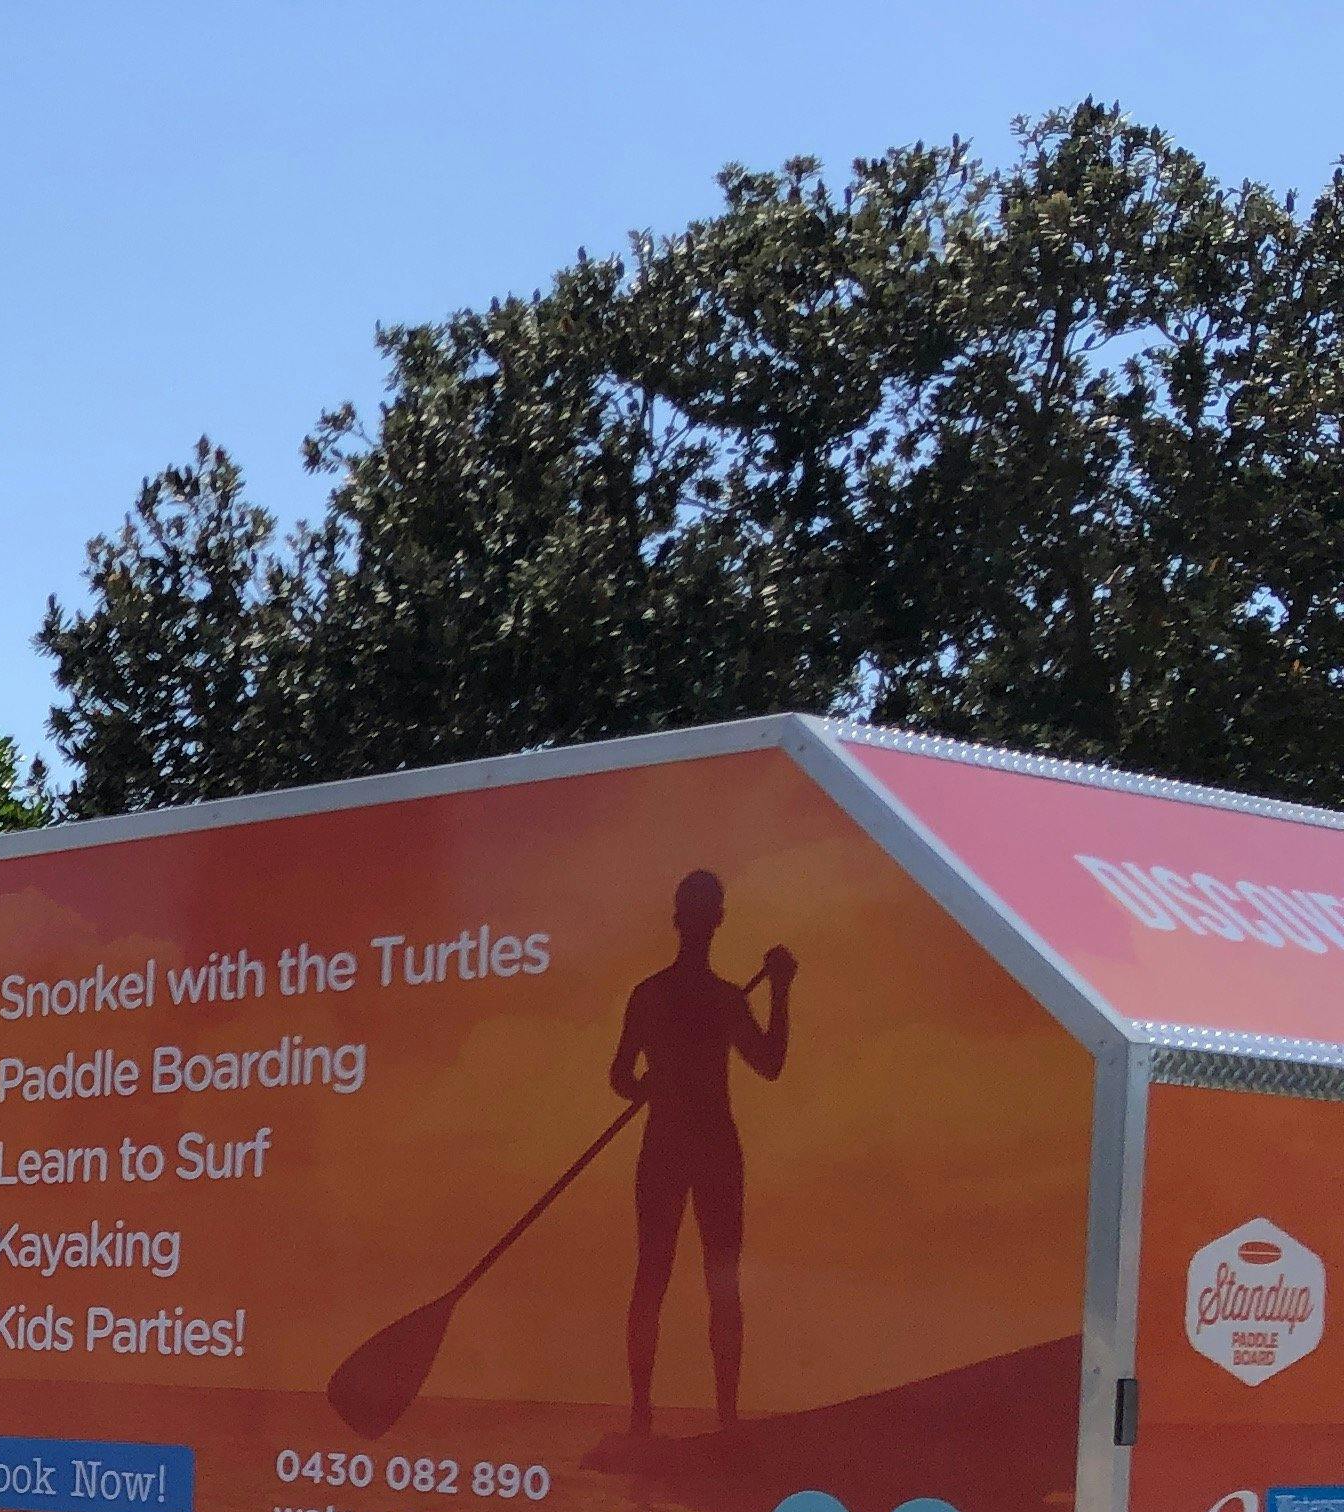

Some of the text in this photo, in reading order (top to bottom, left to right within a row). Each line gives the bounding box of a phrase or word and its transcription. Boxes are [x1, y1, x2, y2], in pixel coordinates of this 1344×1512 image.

[0, 924, 551, 1019] Snorkel with the Turtles
[151, 1036, 367, 1094] Boarding
[119, 1137, 164, 1181] to
[176, 1127, 272, 1180] Surf
[1196, 1262, 1313, 1334] Standup
[86, 1308, 247, 1357] Parties!
[69, 1458, 168, 1503] Now!
[275, 1449, 551, 1500] 0430 082 890
